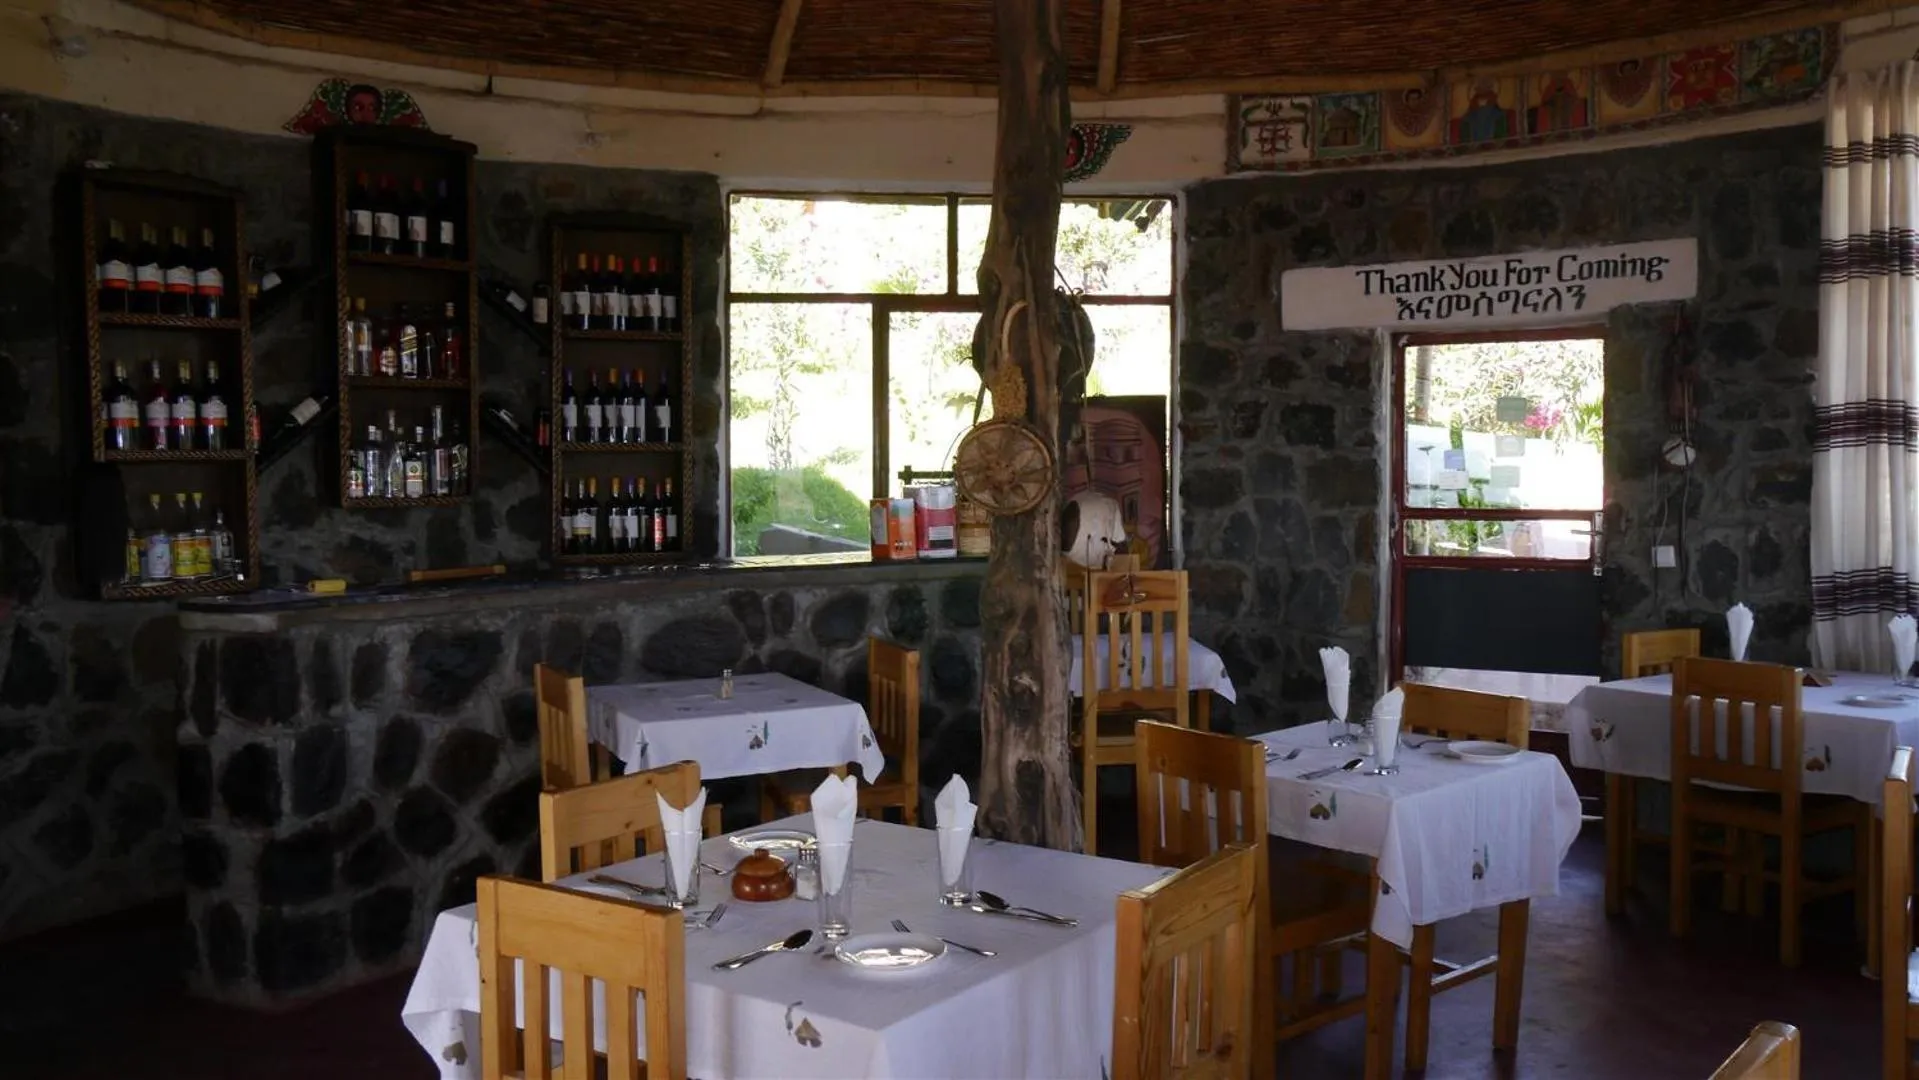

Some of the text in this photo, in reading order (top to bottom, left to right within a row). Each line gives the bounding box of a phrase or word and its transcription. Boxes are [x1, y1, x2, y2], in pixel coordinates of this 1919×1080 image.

[1355, 252, 1669, 295] Thank You For Coming
[1396, 285, 1586, 320] እናመሰግናለን
